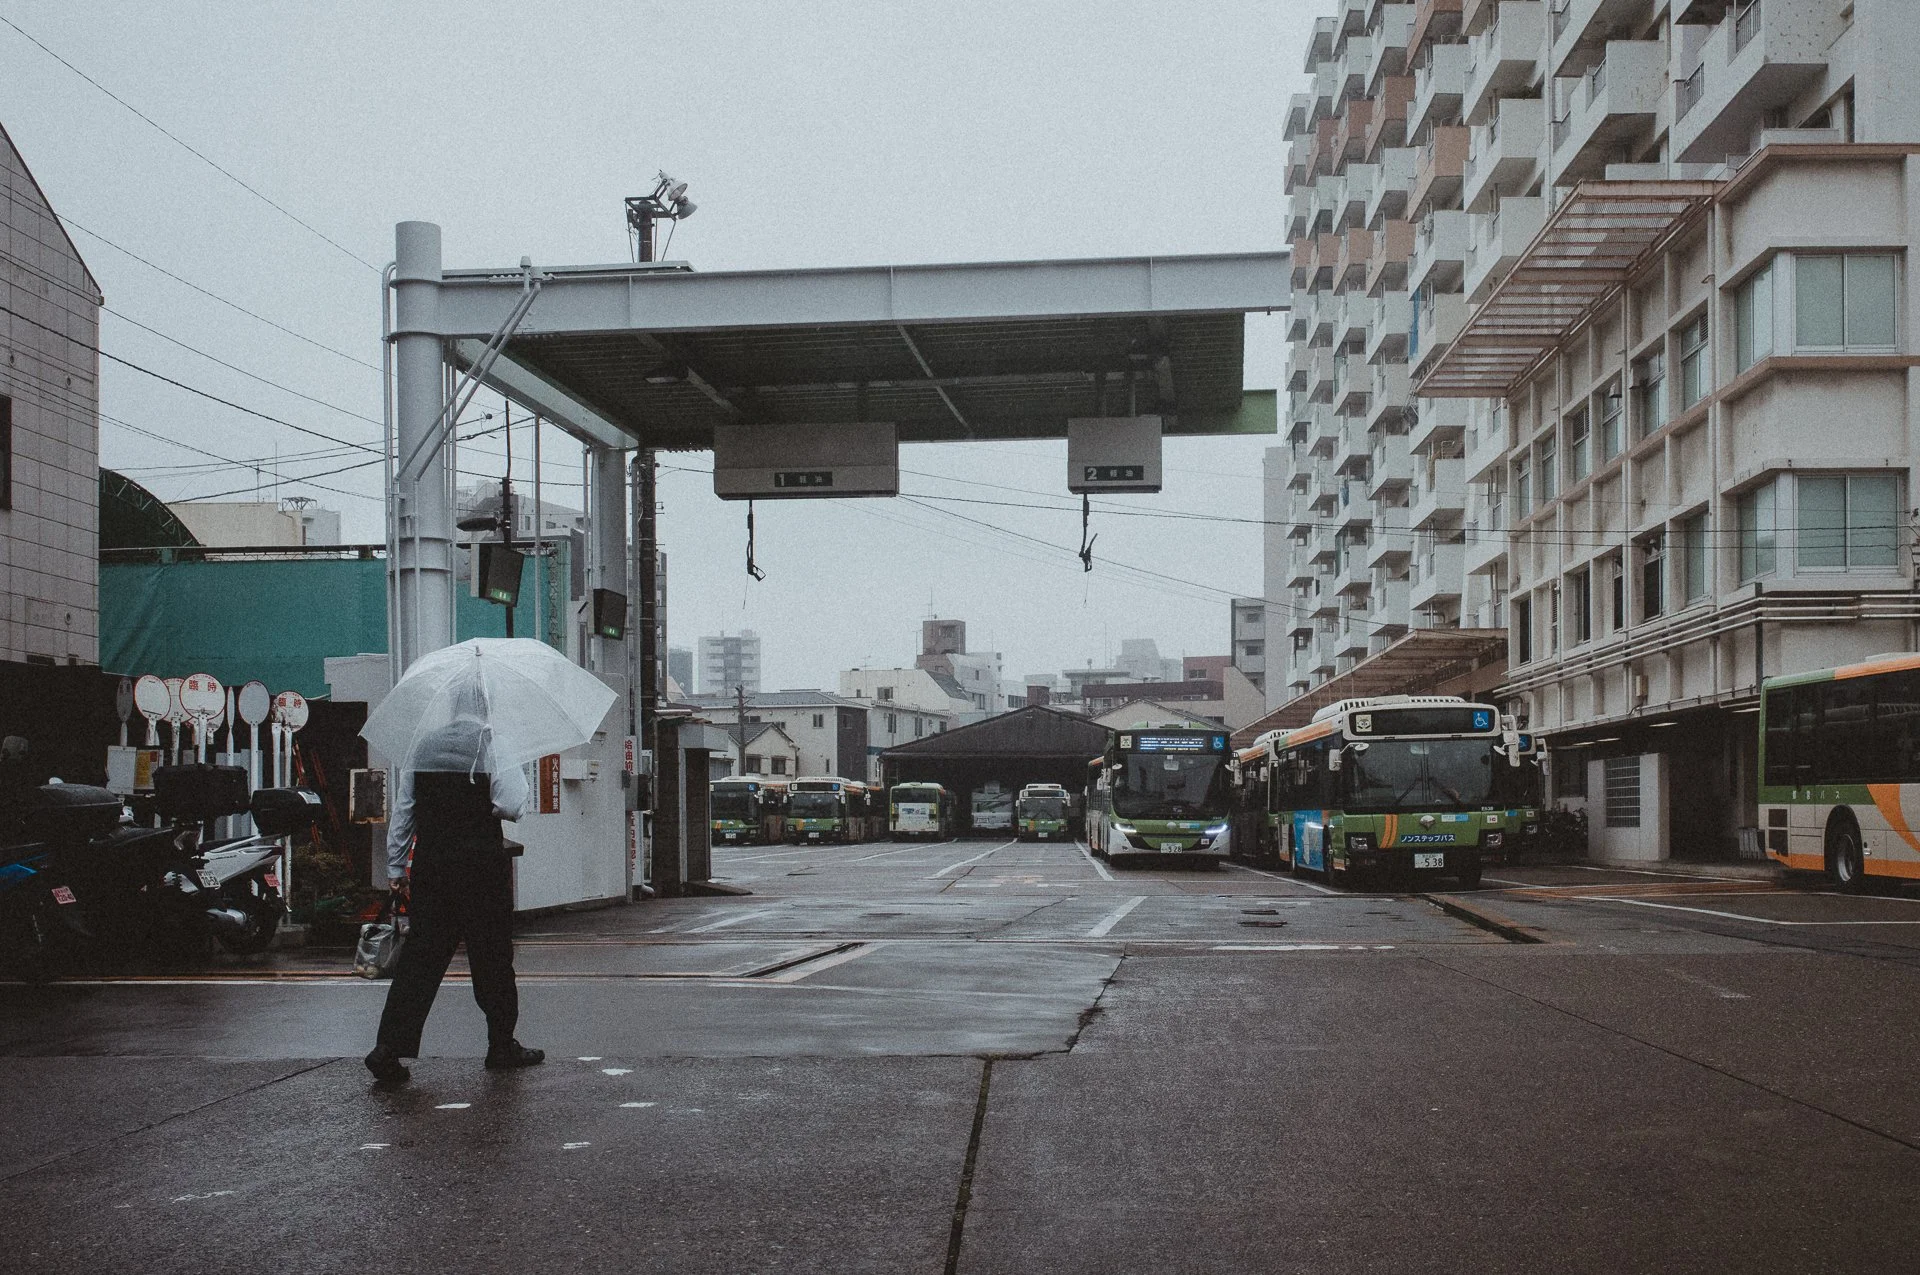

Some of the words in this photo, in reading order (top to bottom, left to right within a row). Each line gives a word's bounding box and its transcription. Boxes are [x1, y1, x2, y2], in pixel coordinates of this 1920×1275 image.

[1087, 467, 1098, 480] 2
[779, 474, 785, 487] 1
[188, 679, 217, 693] 臨時
[1401, 834, 1455, 843] ノンステップバス
